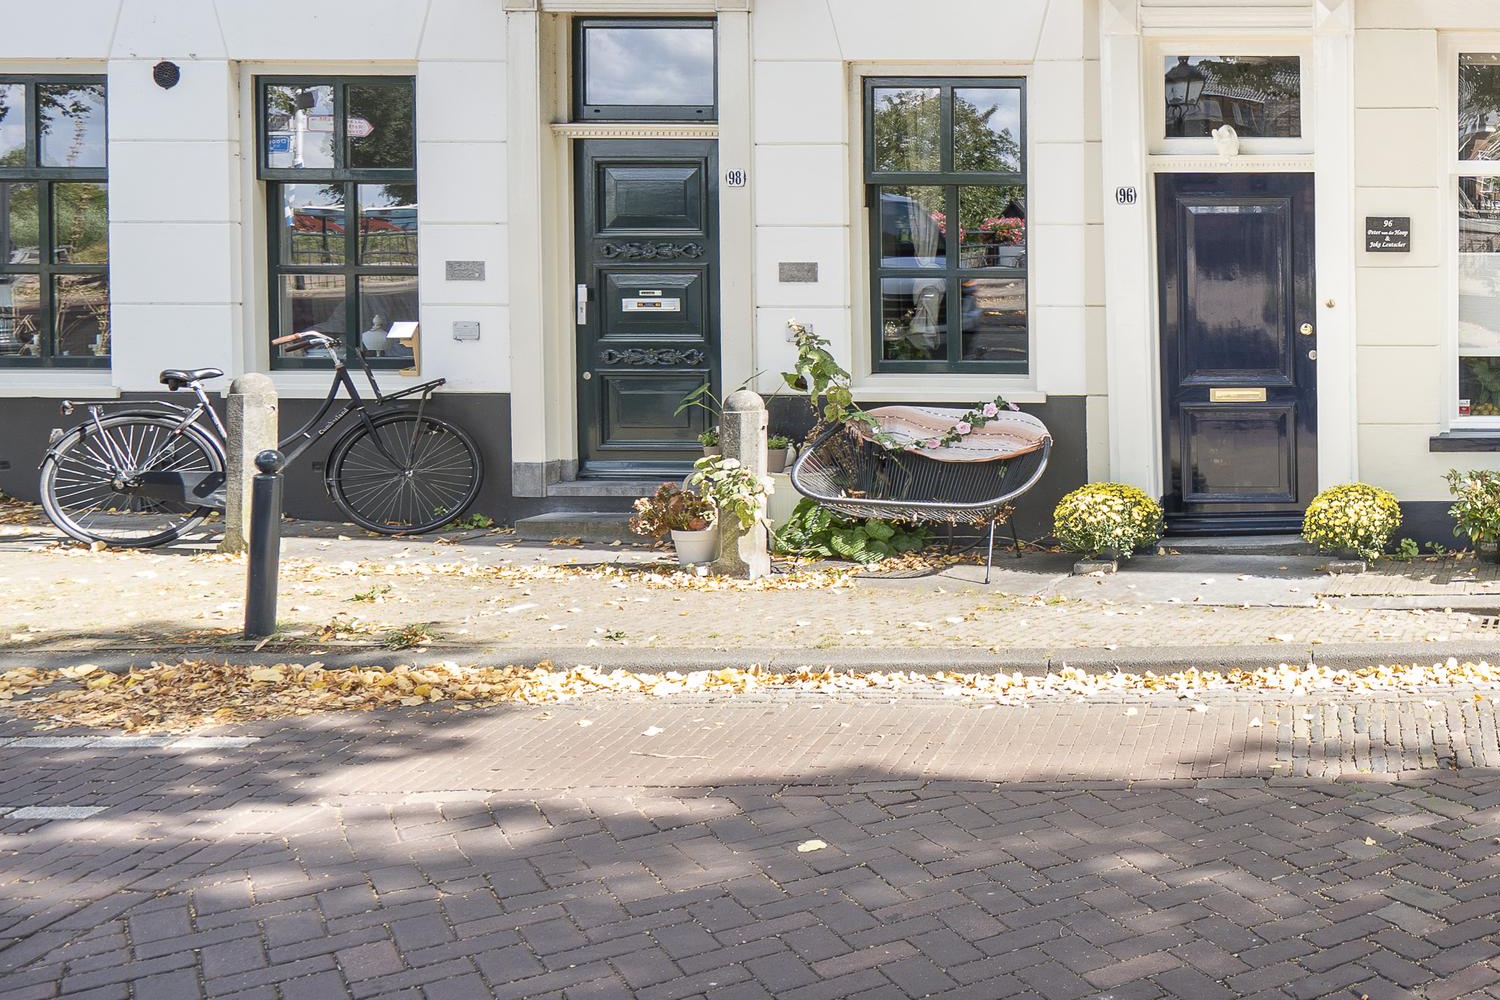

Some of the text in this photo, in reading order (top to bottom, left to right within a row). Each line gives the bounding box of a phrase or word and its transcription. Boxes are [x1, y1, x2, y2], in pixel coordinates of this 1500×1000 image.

[728, 170, 742, 186] 98
[1119, 187, 1133, 203] 96
[1383, 219, 1393, 228] 96
